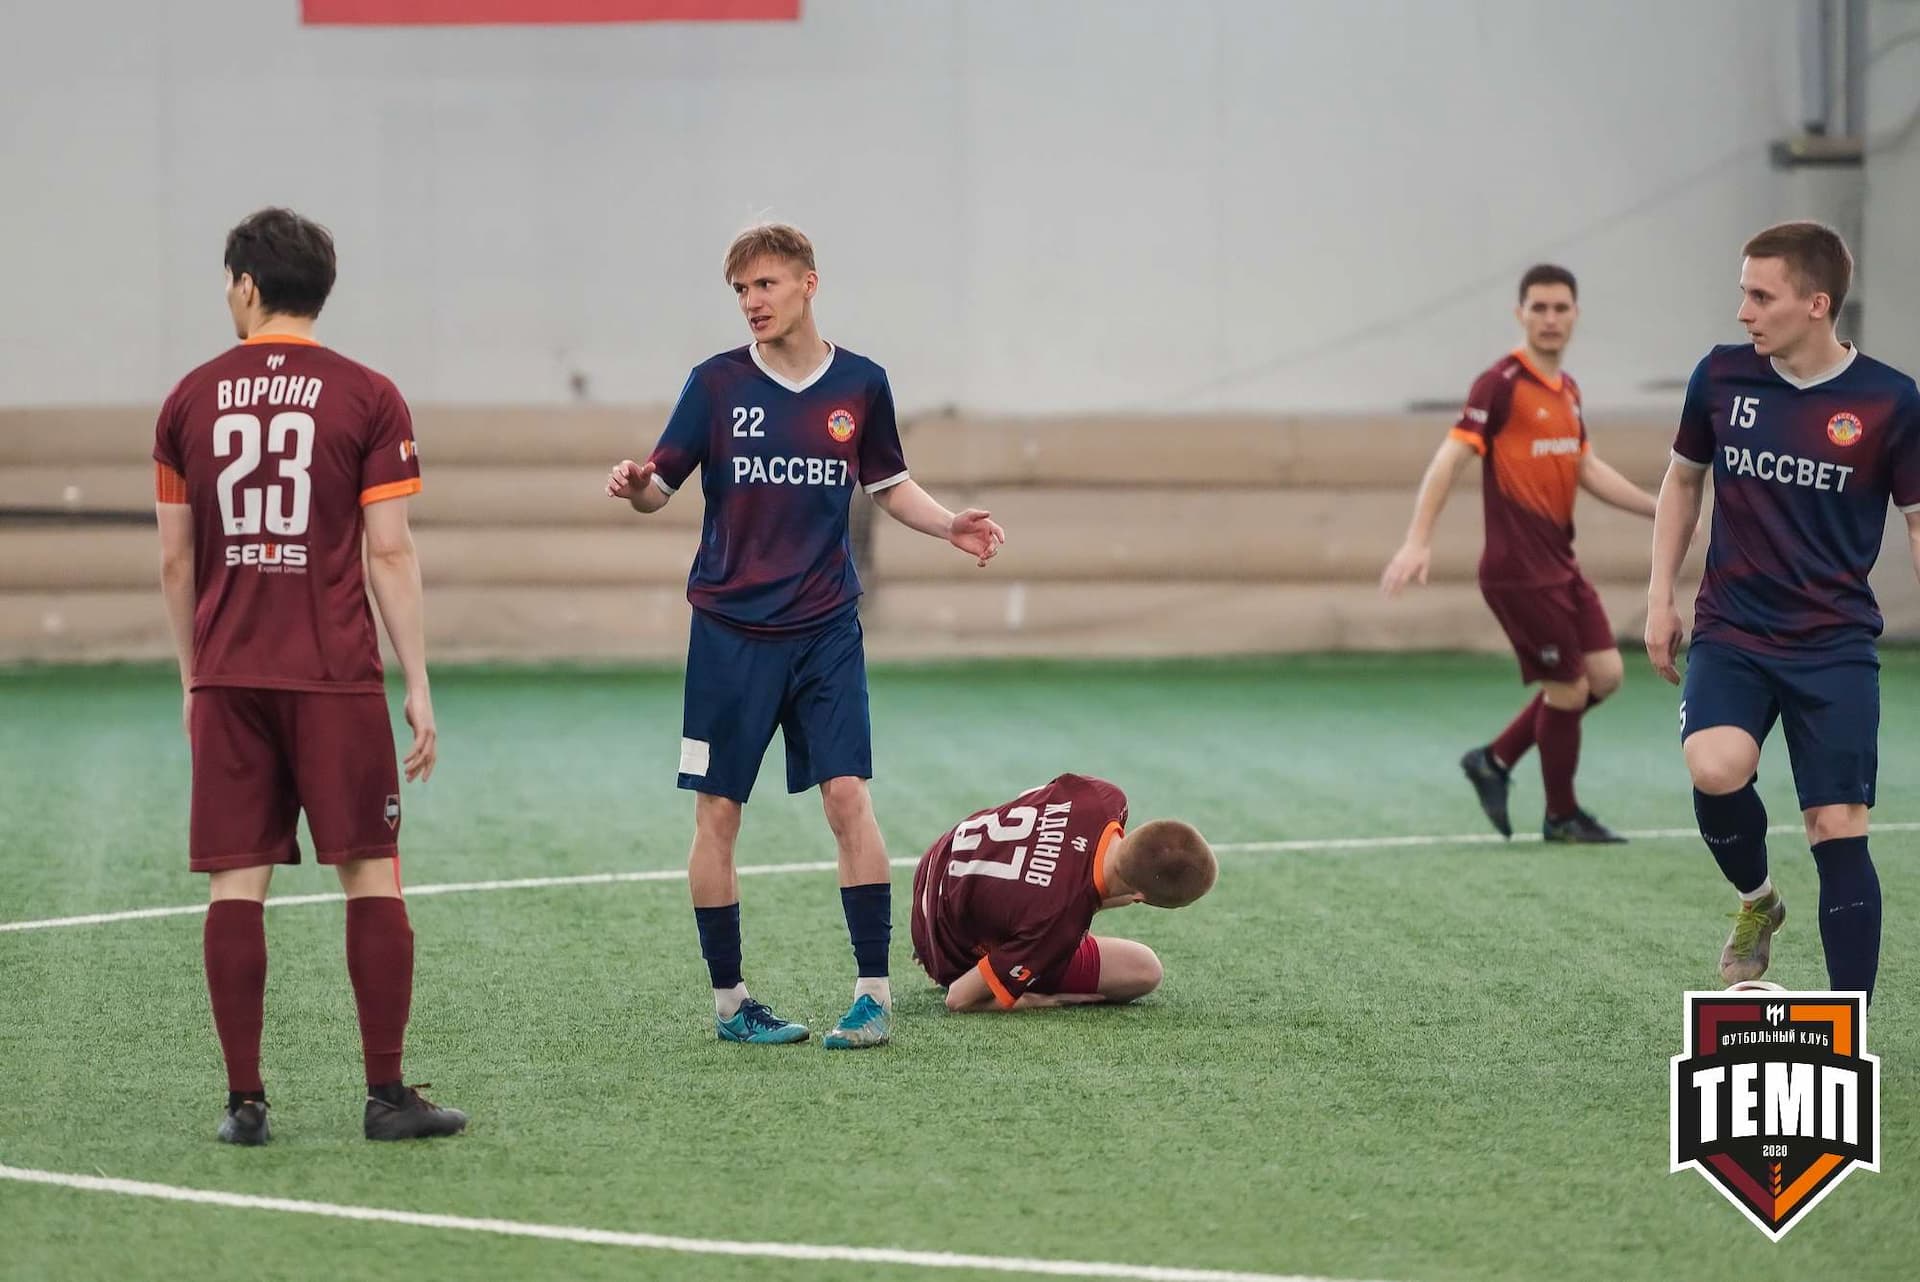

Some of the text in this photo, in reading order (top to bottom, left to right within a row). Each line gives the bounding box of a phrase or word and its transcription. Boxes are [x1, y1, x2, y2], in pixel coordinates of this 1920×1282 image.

[217, 375, 324, 411] ВОРОНА
[1729, 394, 1760, 429] 15
[732, 406, 765, 438] 22
[212, 411, 316, 537] 23
[1724, 445, 1854, 493] РАССВЕТ
[225, 543, 308, 567] SEUS
[949, 805, 1038, 881] 27
[1024, 800, 1073, 888] ЖДАНОВ
